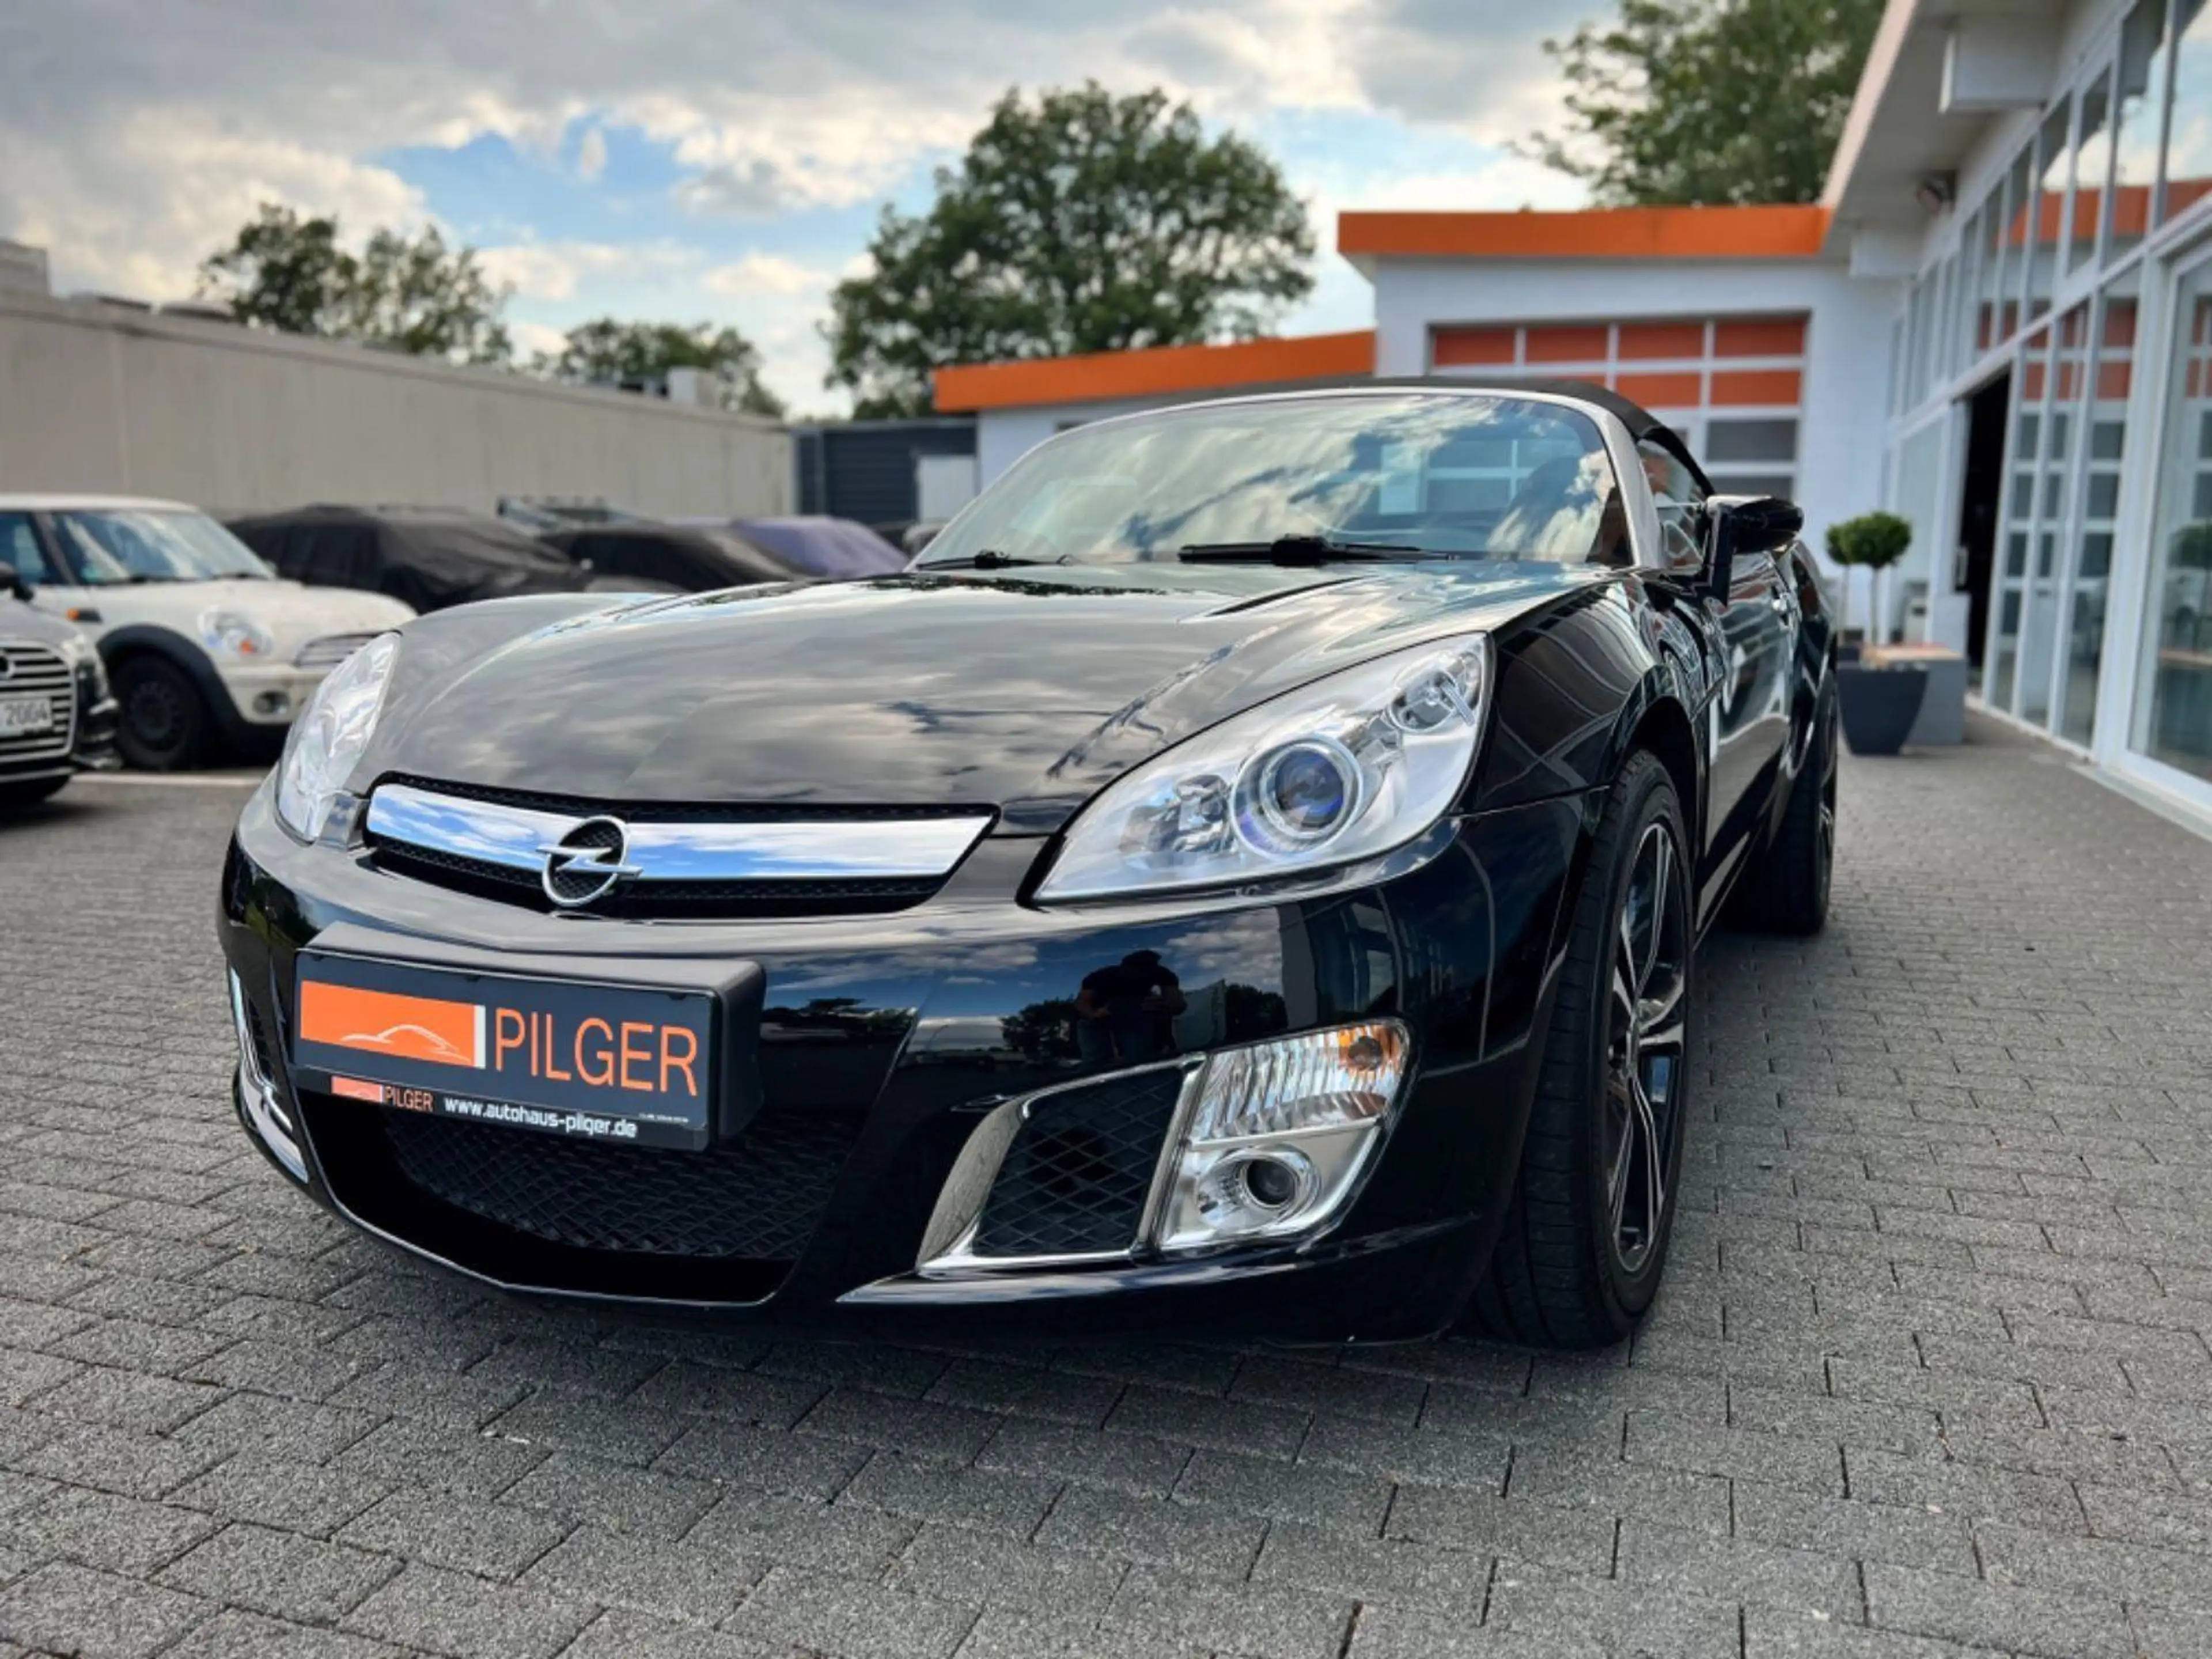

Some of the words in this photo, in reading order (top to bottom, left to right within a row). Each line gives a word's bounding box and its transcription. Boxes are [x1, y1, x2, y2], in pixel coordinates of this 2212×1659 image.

[495, 1007, 698, 1096] PILGER
[384, 1085, 434, 1112] PILGER
[444, 1097, 638, 1138] www.autohaus-pilger.de
